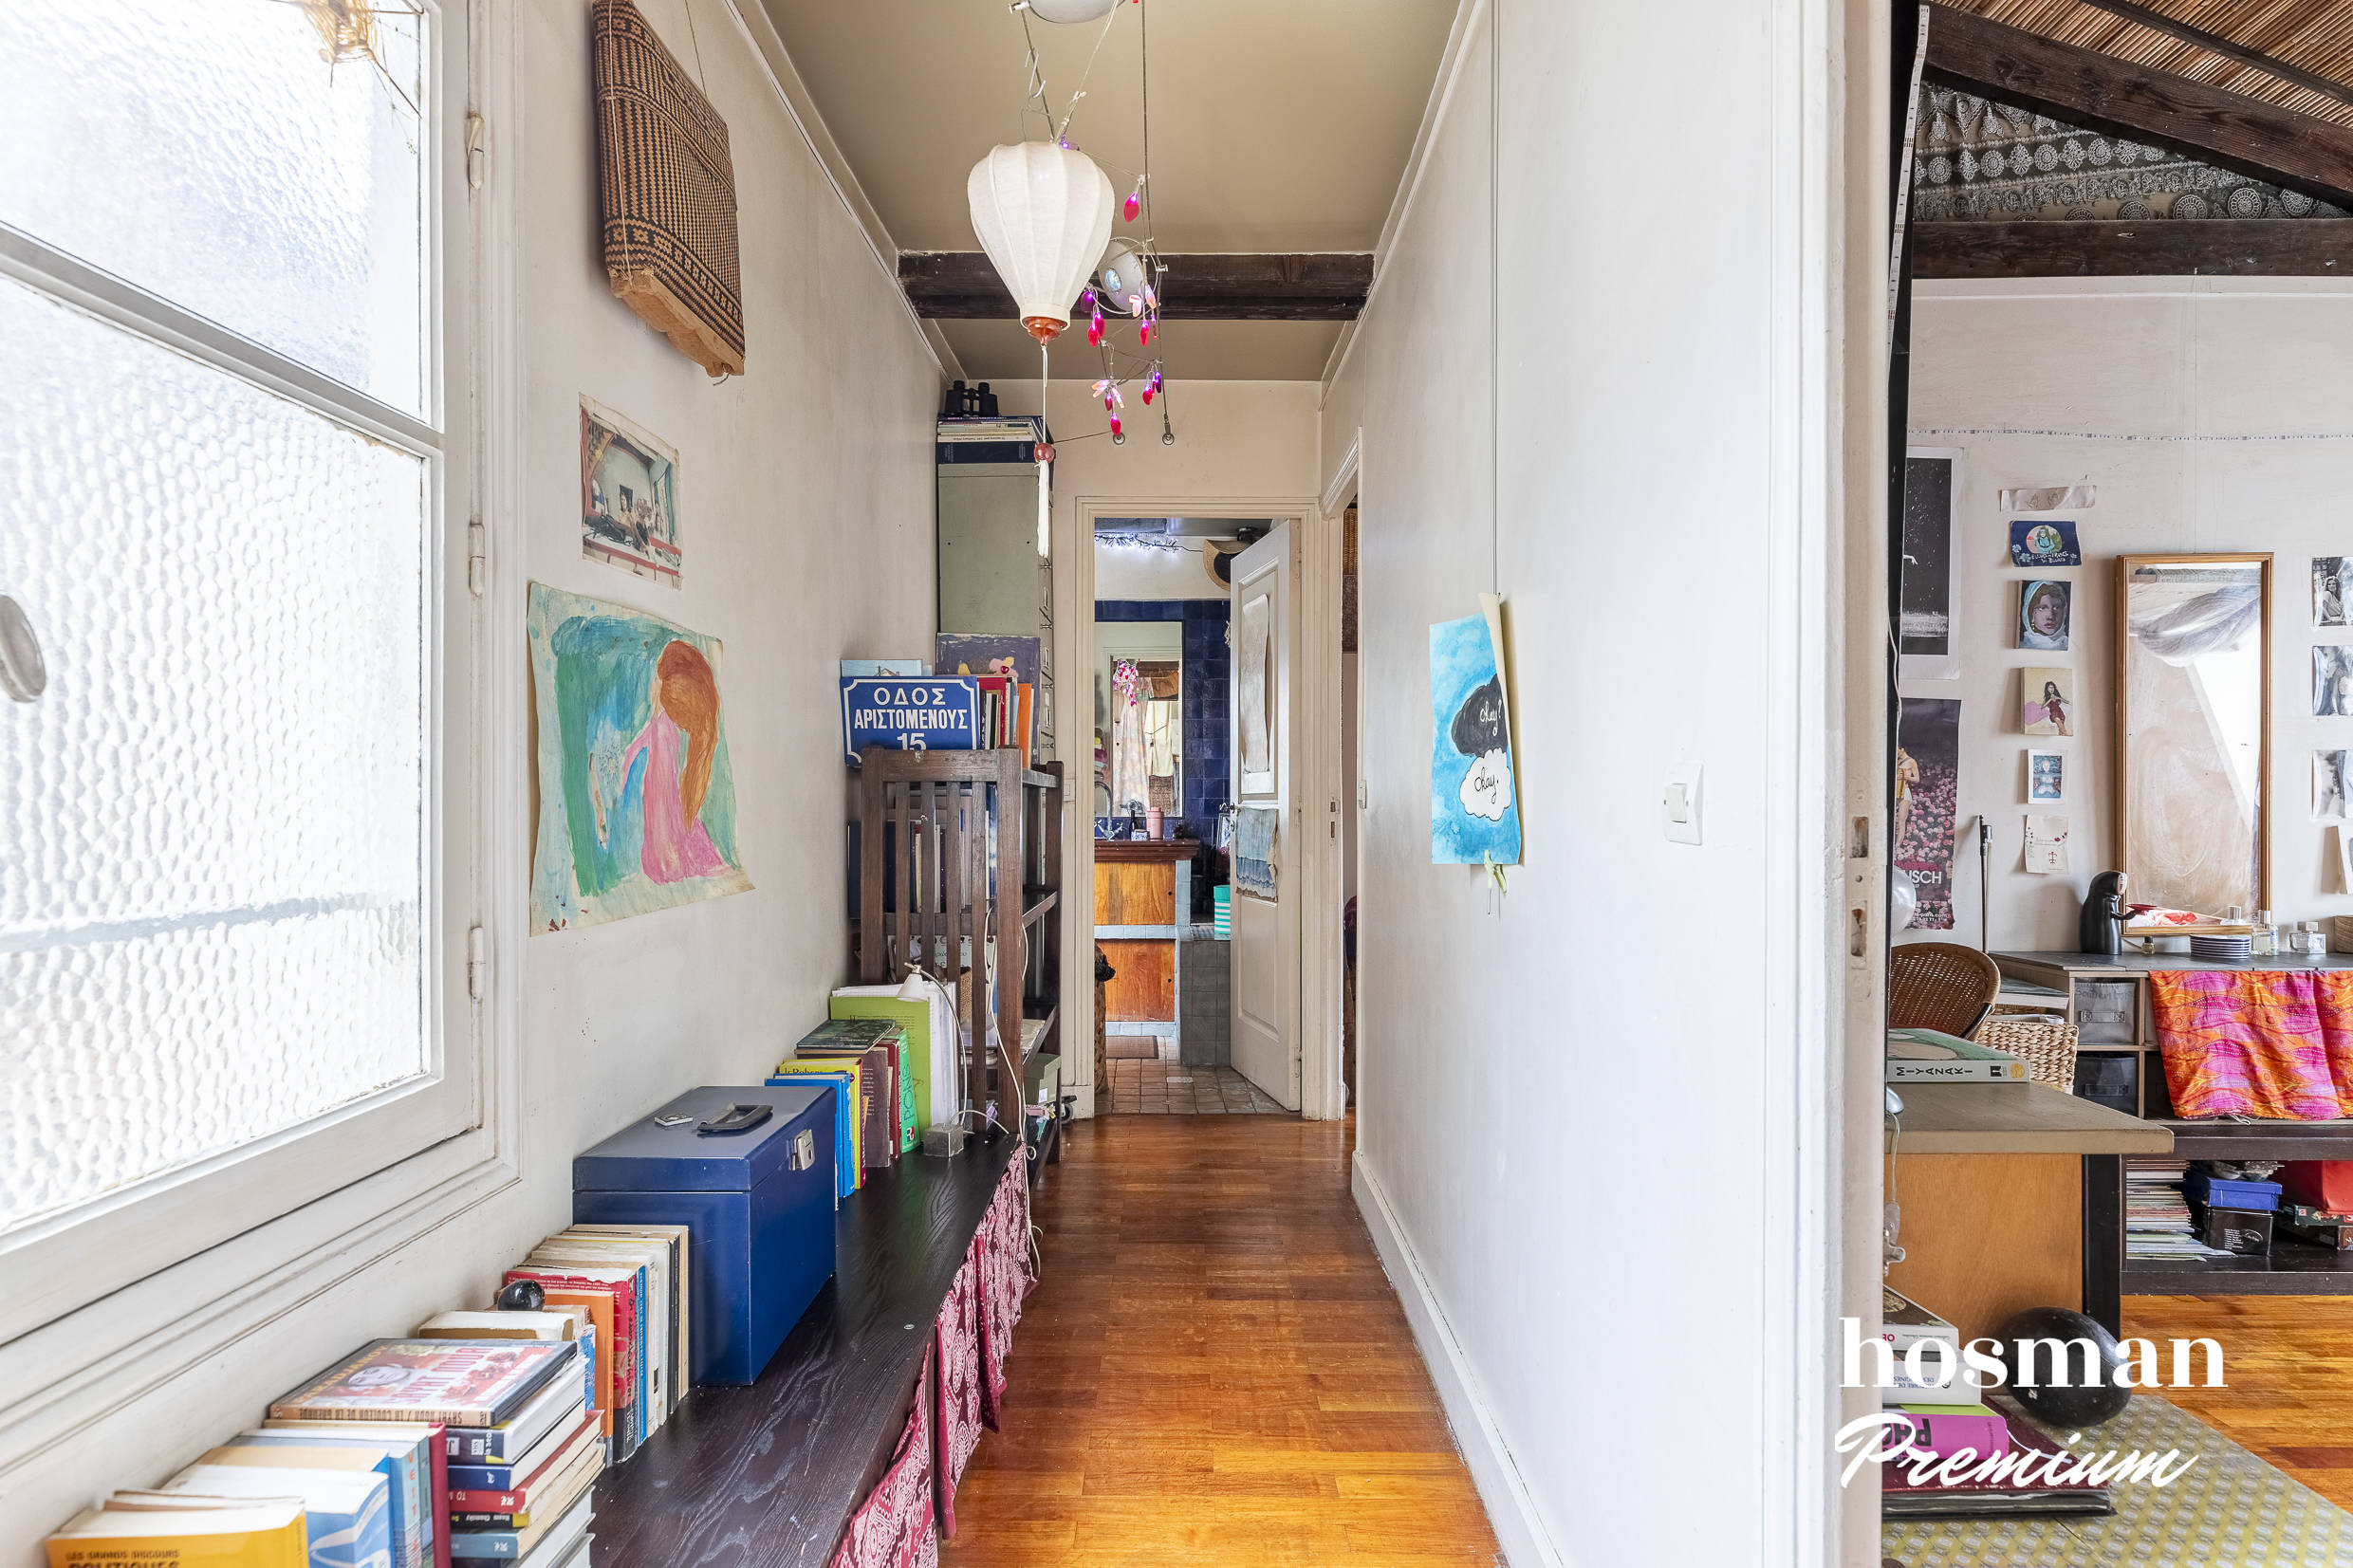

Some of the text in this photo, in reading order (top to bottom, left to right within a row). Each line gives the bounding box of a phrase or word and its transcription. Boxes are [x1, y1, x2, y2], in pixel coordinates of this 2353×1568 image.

[873, 687, 947, 706] ΟΔΟΣ
[854, 709, 969, 729] ΑΡΙΣΤΟΜΕΝΟΥΣ
[897, 732, 927, 750] 15
[1896, 1066, 1973, 1077] MIYAZAKI
[902, 1062, 916, 1122] PONS
